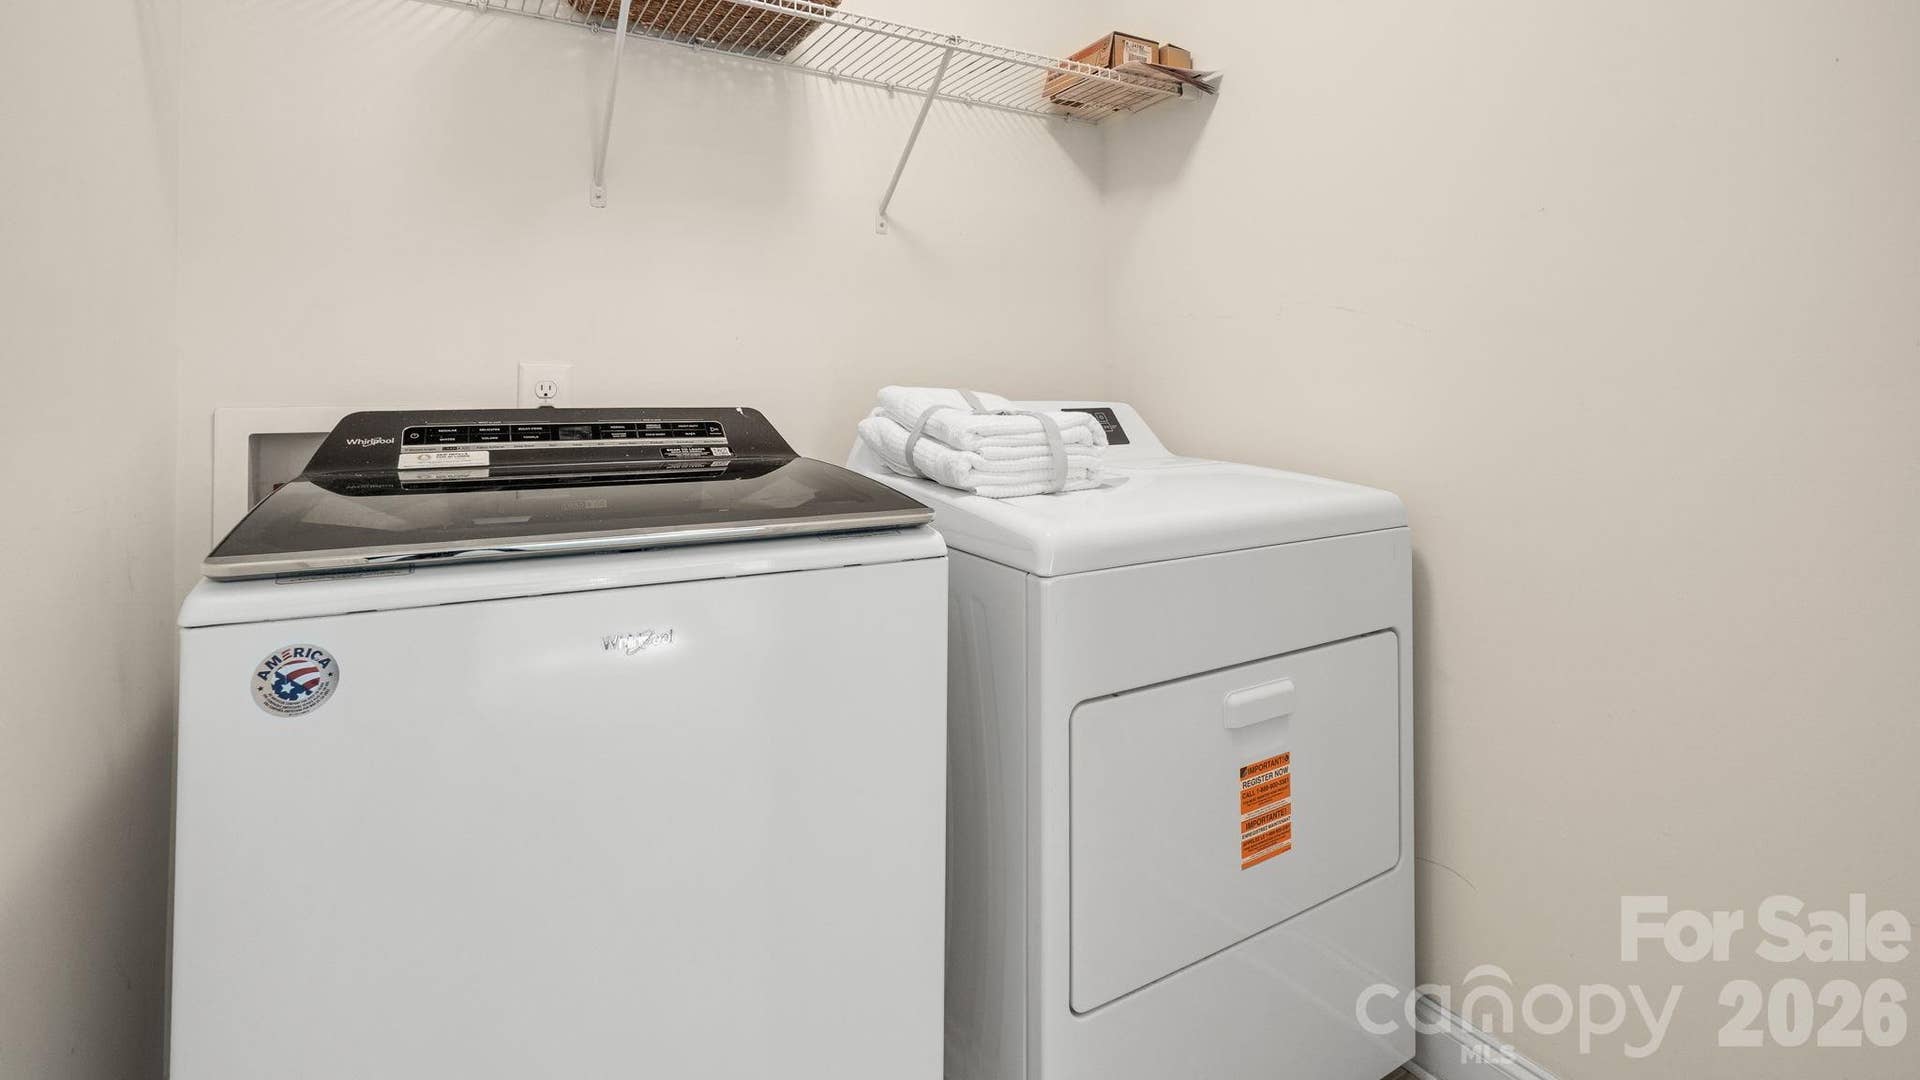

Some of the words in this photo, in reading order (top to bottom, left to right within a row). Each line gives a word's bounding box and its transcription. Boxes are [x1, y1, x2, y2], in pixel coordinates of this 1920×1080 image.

[346, 437, 395, 448] Whirlpool
[257, 647, 332, 681] AMERICA
[1242, 772, 1274, 789] REGISTER
[1274, 766, 1289, 778] NOW
